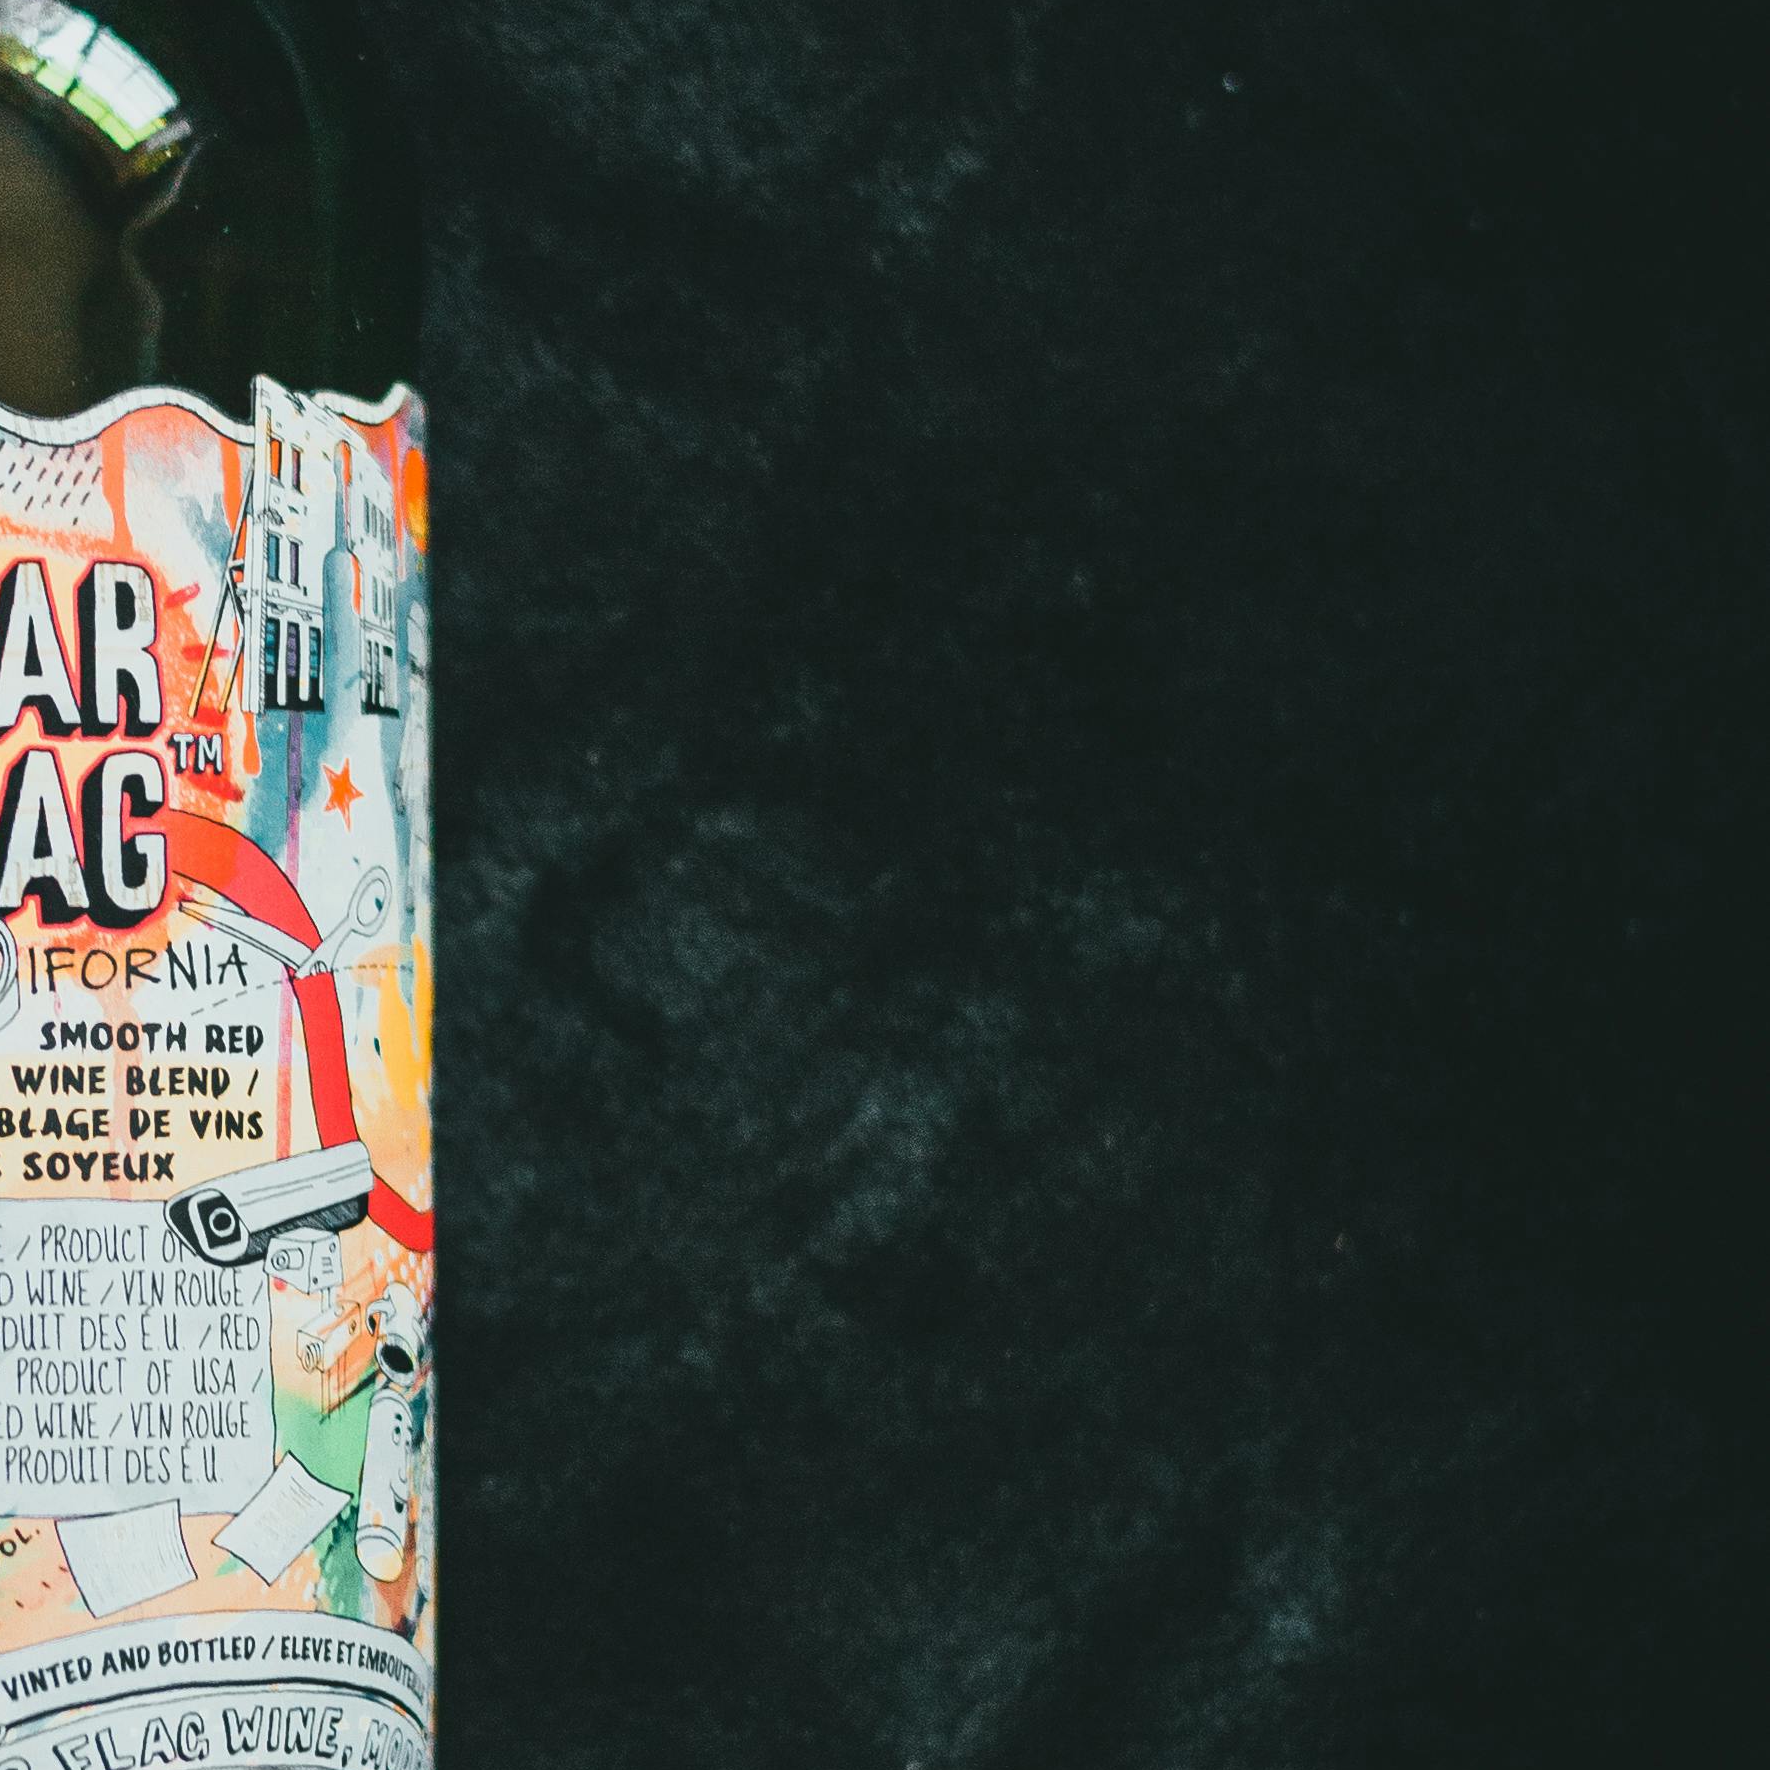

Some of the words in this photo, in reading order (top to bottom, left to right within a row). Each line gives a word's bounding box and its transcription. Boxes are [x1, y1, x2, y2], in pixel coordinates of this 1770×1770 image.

[172, 733, 223, 774] TM
[39, 1021, 187, 1053] SMOOTH
[205, 1024, 264, 1056] RED
[11, 1064, 106, 1097] WINE
[129, 1065, 230, 1099] BLEND
[129, 1108, 171, 1141] DE
[189, 1110, 264, 1141] VINS
[23, 1151, 175, 1183] SOYEUX
[41, 1224, 149, 1263] PRODUCT
[26, 1269, 91, 1307] WINE
[122, 1270, 164, 1307] VIN
[175, 1268, 244, 1307] ROUGE
[81, 1314, 126, 1351] DES
[221, 1314, 260, 1351] RED
[17, 1357, 126, 1395] PRODUCT
[147, 1360, 172, 1395] OF
[193, 1358, 236, 1394] USA
[35, 1402, 98, 1439] WINE
[130, 1402, 172, 1439] VIN
[182, 1401, 251, 1439] ROUGE
[6, 1447, 113, 1484] PRODUIT
[126, 1447, 171, 1484] DES
[1, 1656, 92, 1702] VINTED
[102, 1645, 150, 1676] AND
[157, 1636, 255, 1667] BOTTLED
[281, 1636, 332, 1661] ELEVE
[337, 1640, 355, 1666] ET
[222, 1705, 353, 1767] WINE,
